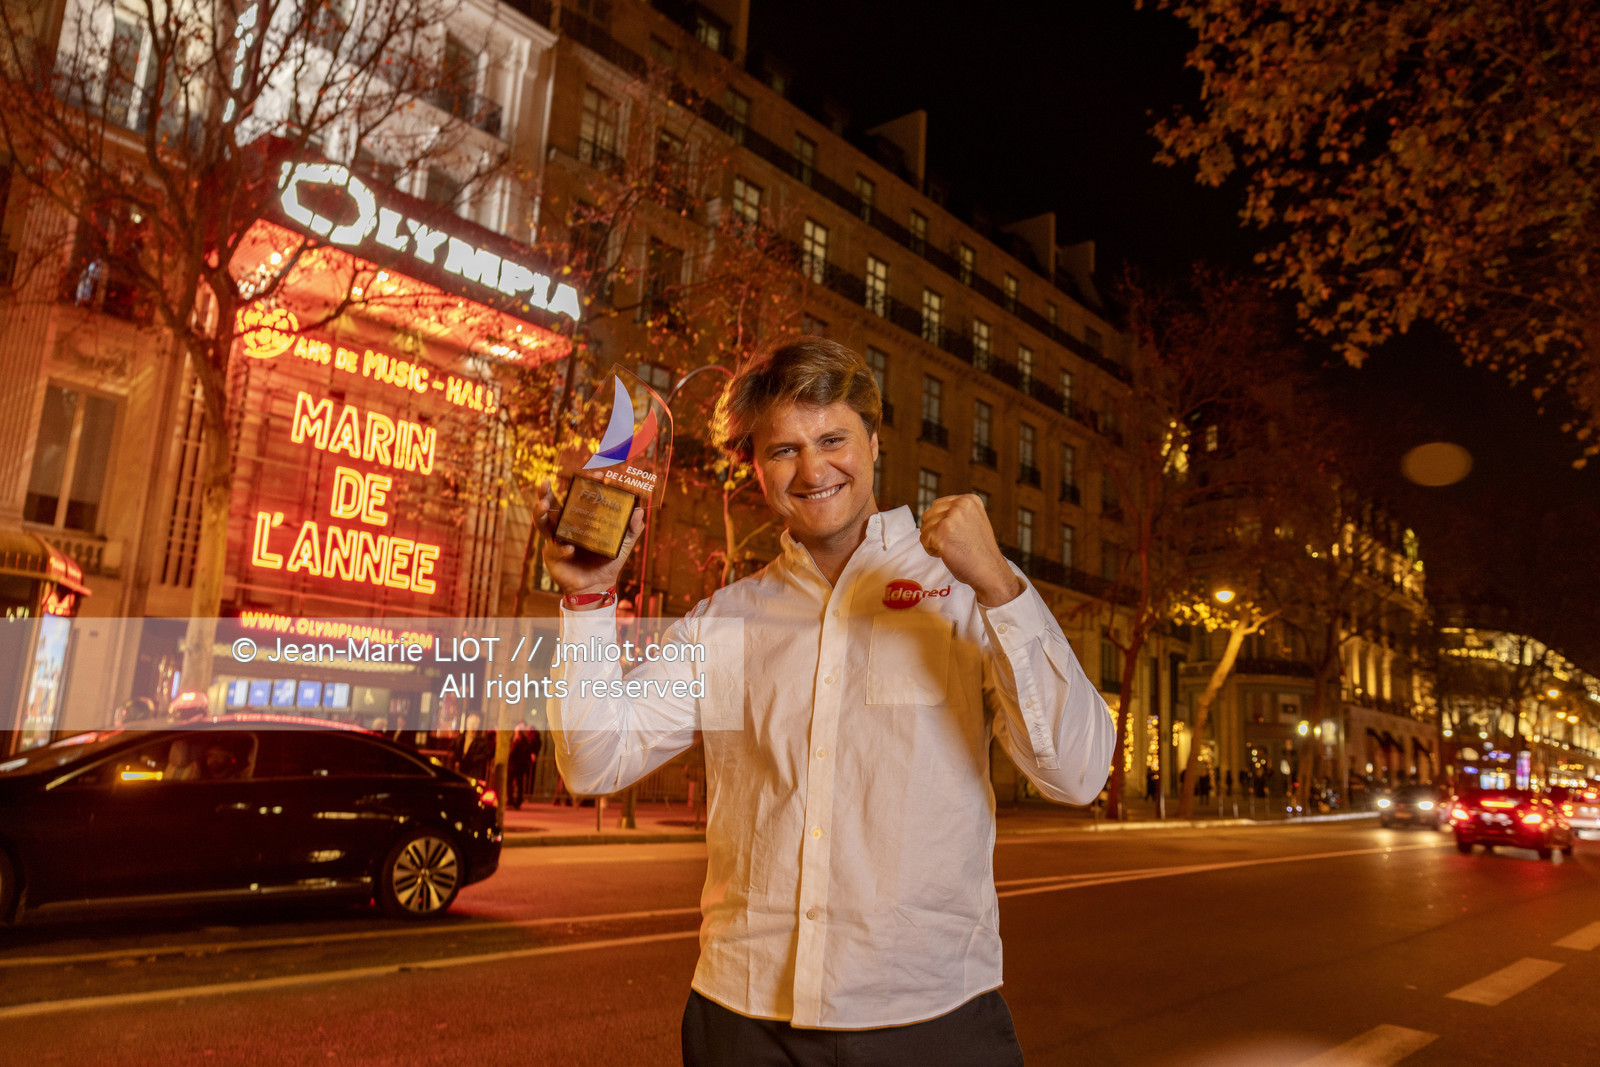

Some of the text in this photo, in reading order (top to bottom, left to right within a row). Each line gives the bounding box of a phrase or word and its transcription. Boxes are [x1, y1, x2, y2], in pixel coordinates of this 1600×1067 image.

[278, 161, 581, 322] OLYMPIA
[294, 336, 332, 365] ANS
[335, 347, 358, 374] DE
[291, 391, 437, 475] MARIN
[330, 466, 392, 527] DE
[605, 470, 655, 492] DE L'ANNÉE
[625, 466, 657, 482] ESPOIR
[252, 511, 440, 595] L'ANNEE
